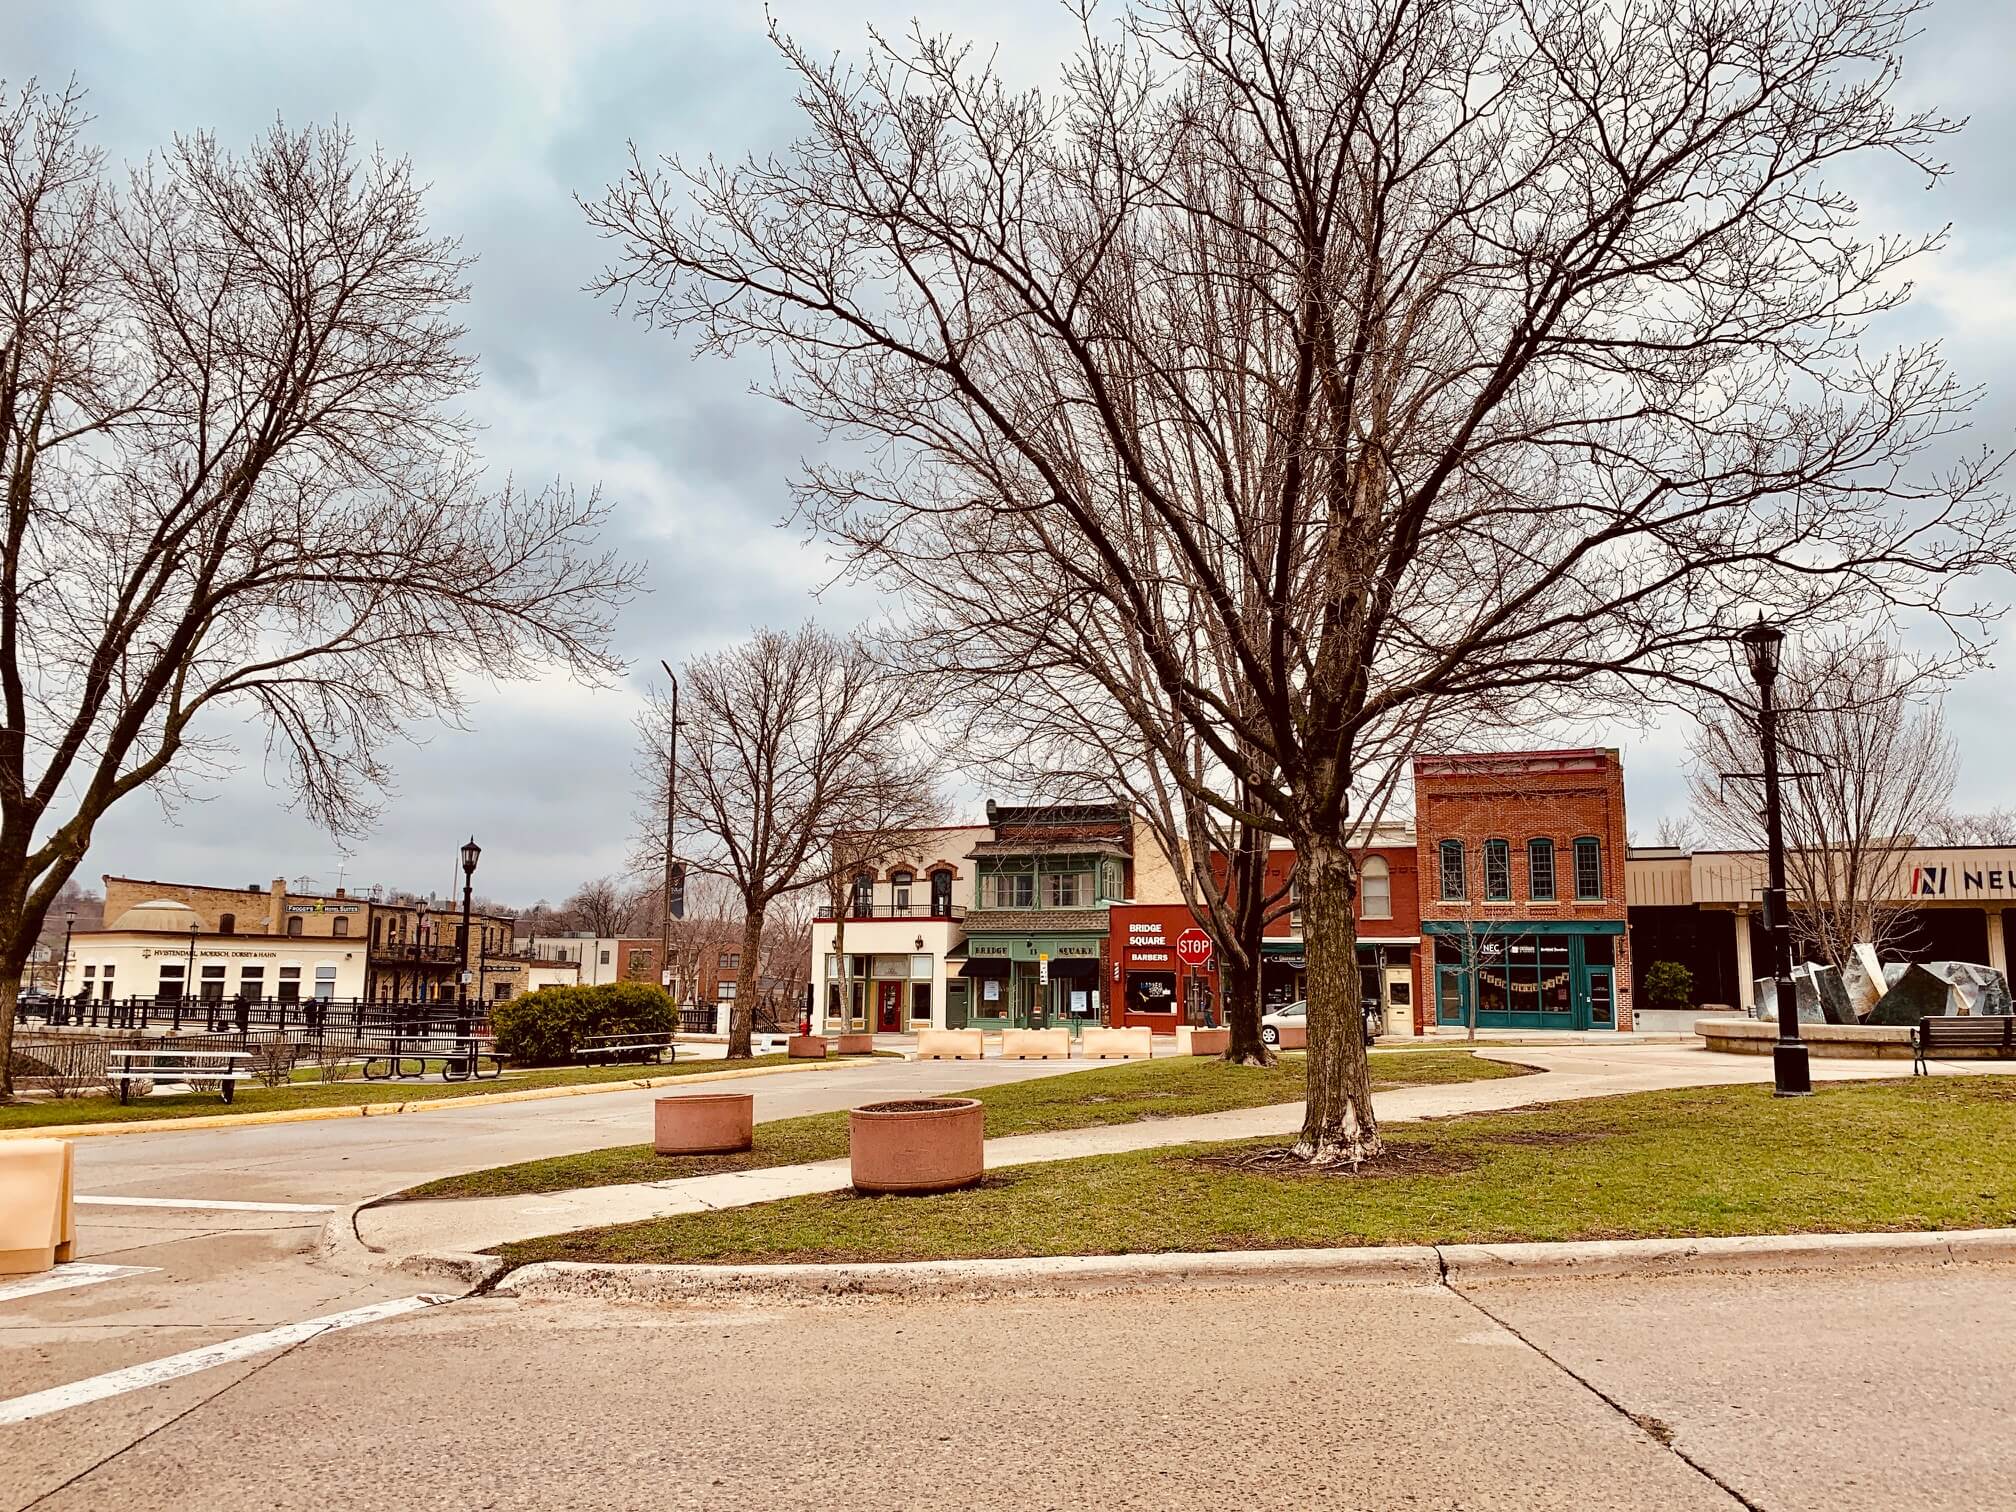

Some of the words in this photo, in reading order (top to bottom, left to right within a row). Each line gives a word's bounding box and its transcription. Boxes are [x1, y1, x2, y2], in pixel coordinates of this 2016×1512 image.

[1129, 924, 1162, 933] BRIDGE
[1129, 936, 1166, 946] SQUARE
[975, 947, 1008, 955] BRIDGE
[1058, 947, 1094, 956] SQUARE
[1180, 940, 1209, 954] STOP
[1483, 944, 1500, 952] NEC
[1131, 953, 1169, 962] BARBERS
